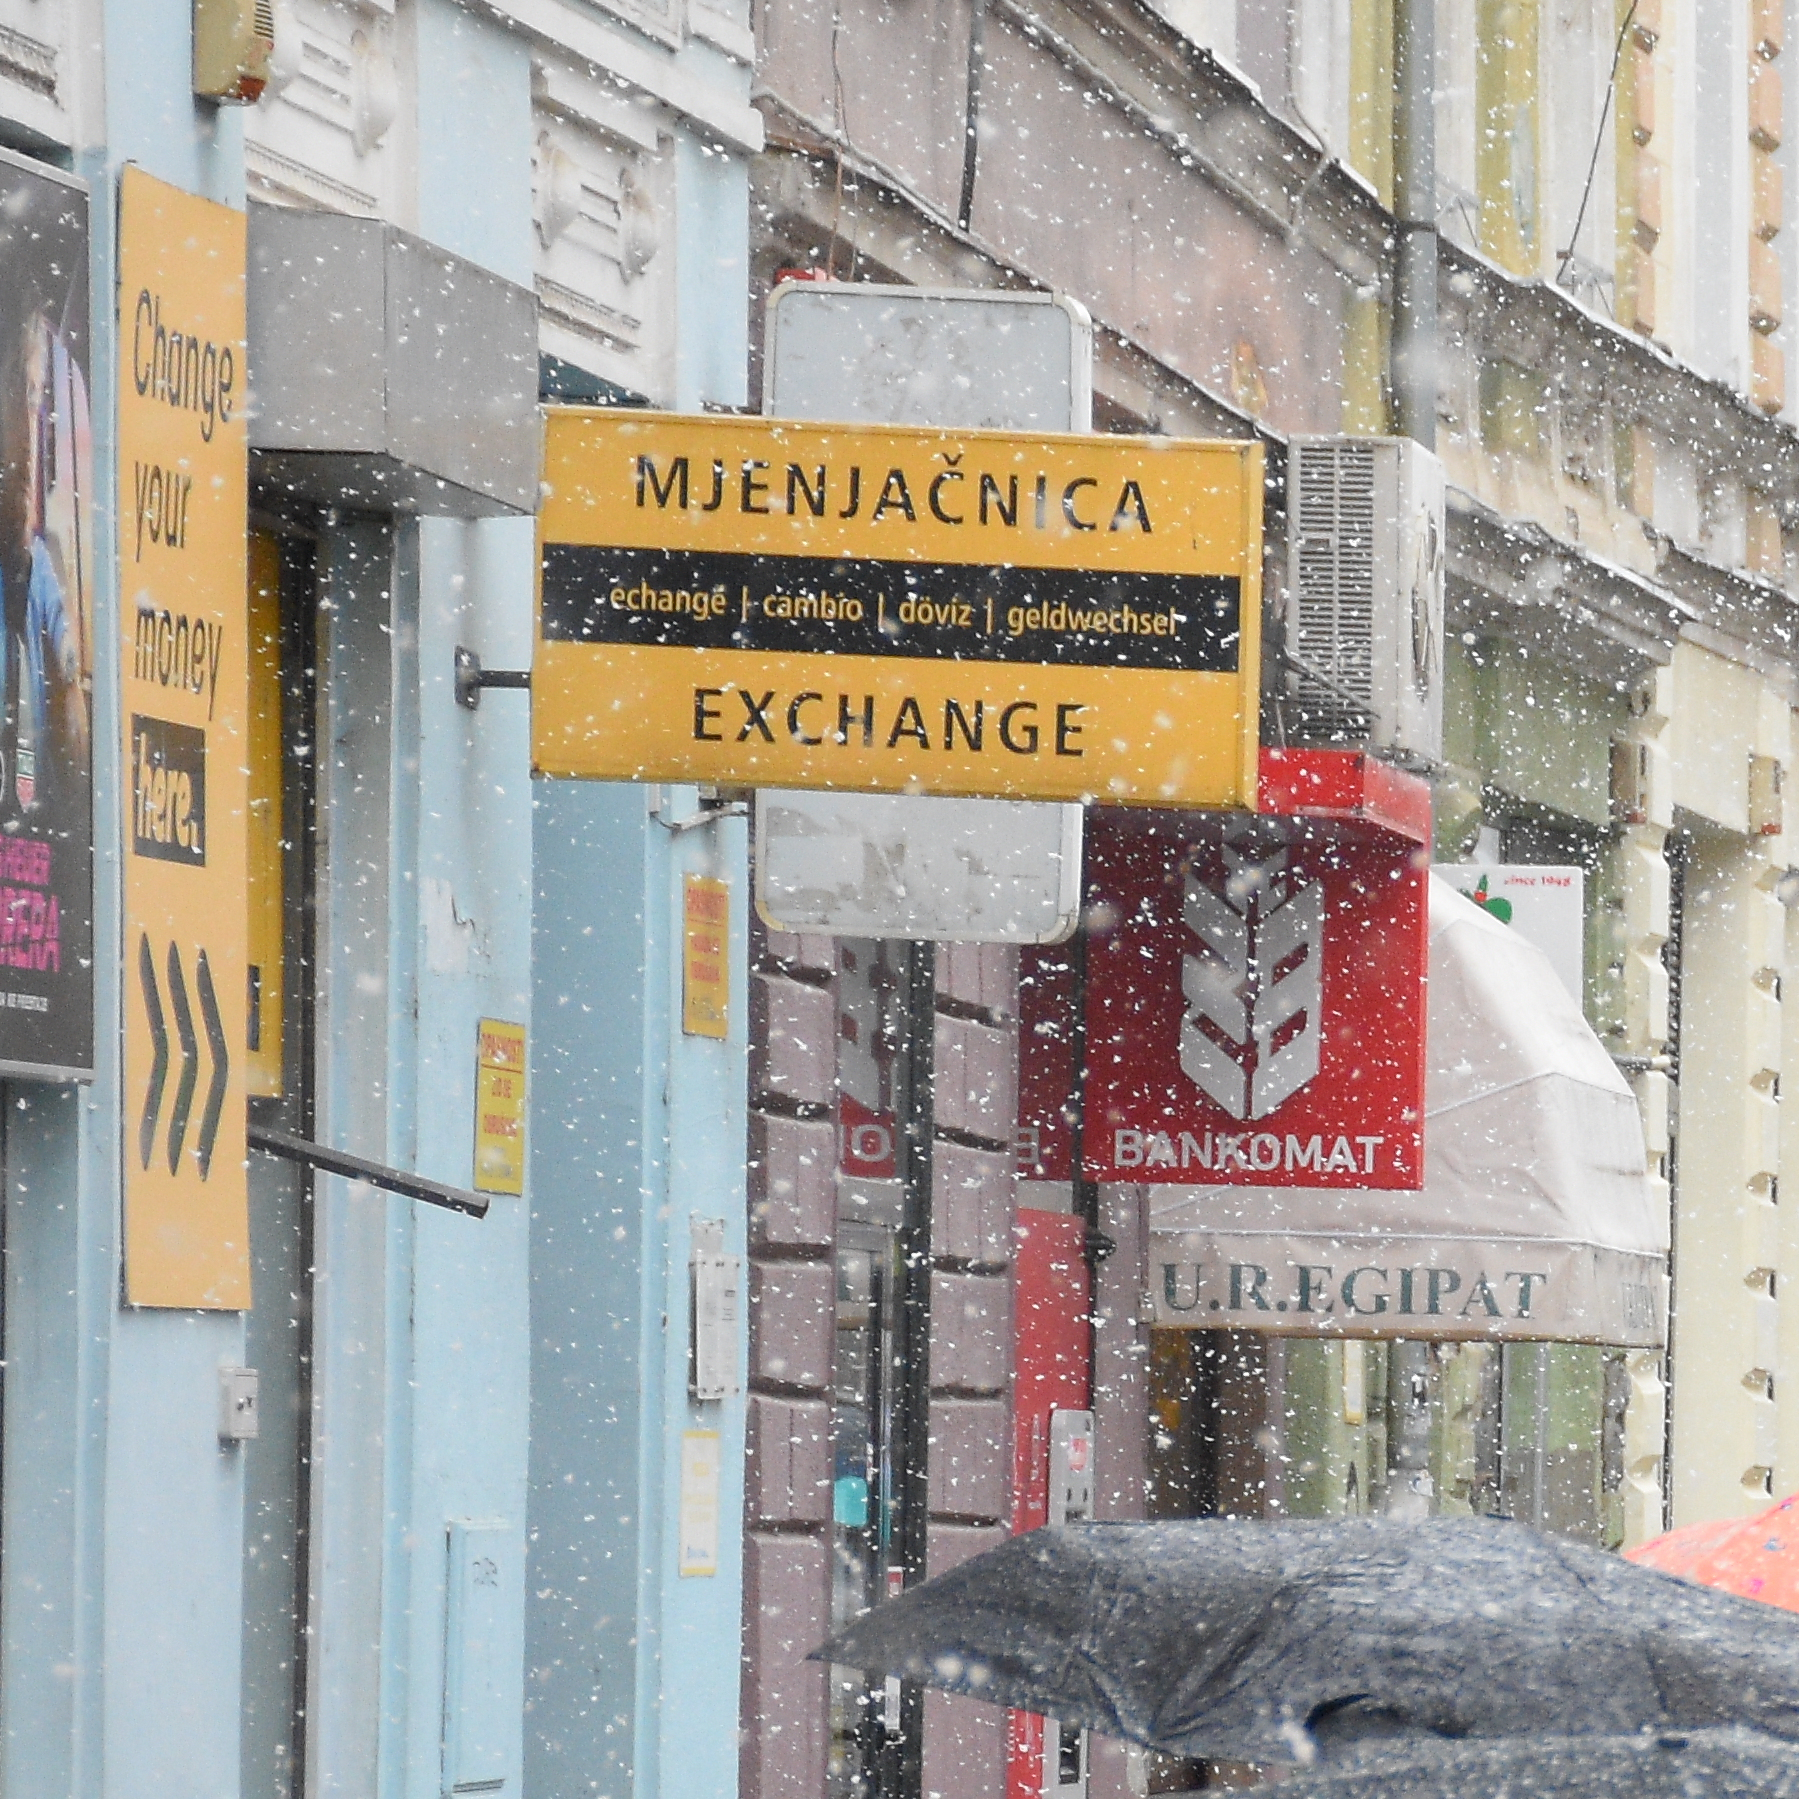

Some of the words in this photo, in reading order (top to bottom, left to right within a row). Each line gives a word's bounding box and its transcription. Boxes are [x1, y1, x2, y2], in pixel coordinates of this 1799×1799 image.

[133, 288, 233, 443] Change
[134, 460, 192, 563] your
[635, 453, 1152, 533] MJENJAČNICA
[610, 586, 726, 620] echange
[762, 591, 863, 622] cambio
[899, 597, 972, 627] döviz
[1007, 603, 1177, 637] geldwechsel
[135, 605, 223, 721] money
[692, 687, 1087, 757] EXCHANGE
[137, 732, 200, 853] here.
[1113, 1128, 1384, 1174] BANKOMAT
